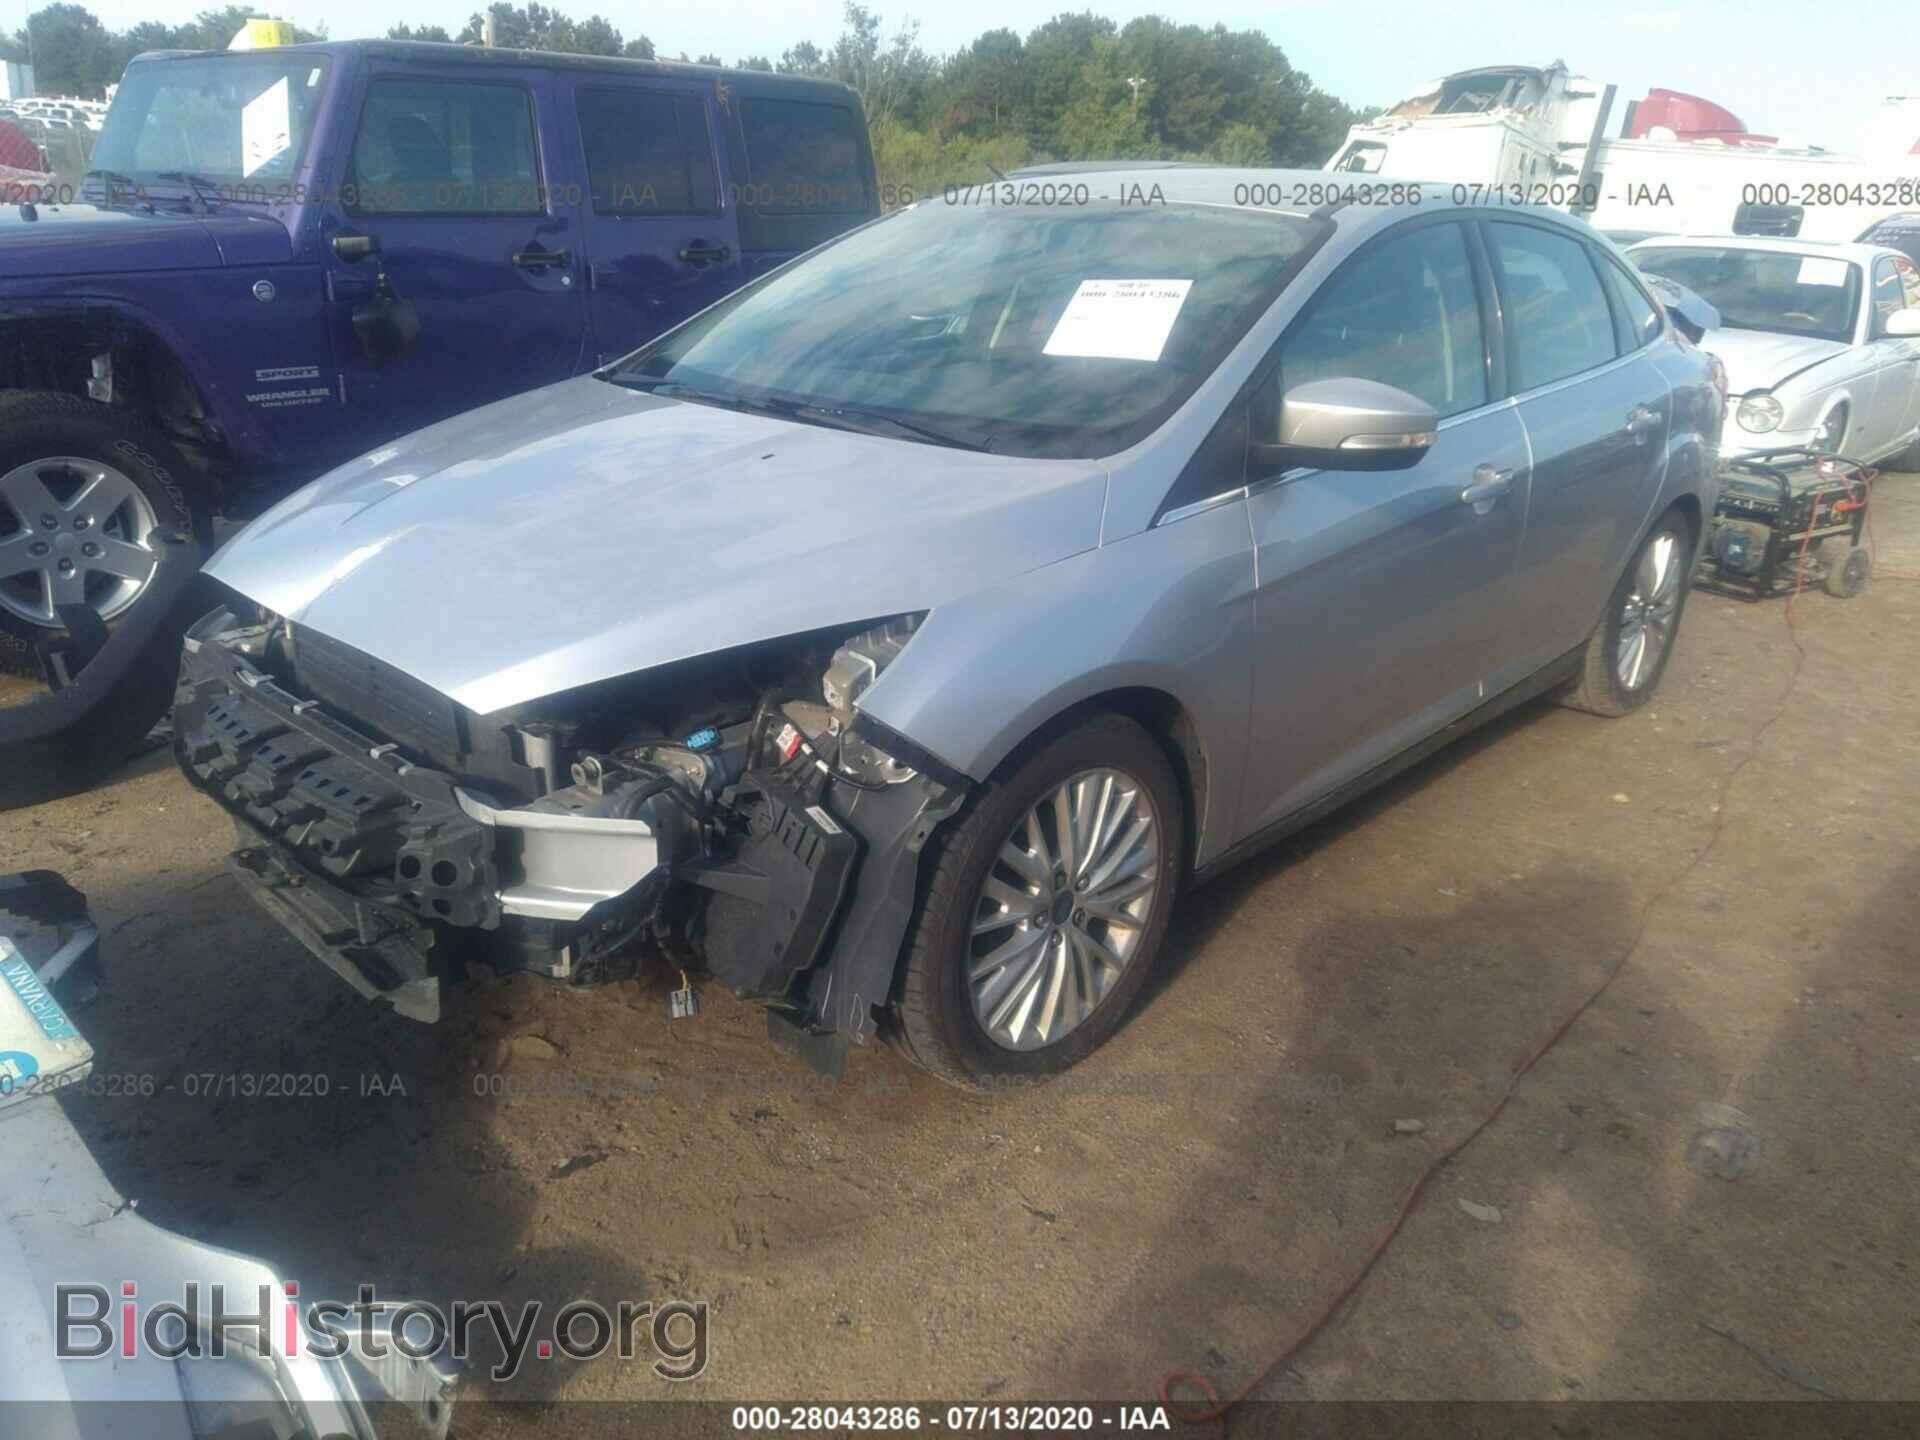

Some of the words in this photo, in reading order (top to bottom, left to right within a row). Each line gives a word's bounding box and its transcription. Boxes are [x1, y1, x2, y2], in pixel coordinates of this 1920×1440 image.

[256, 367, 319, 381] SPORT
[246, 388, 330, 402] WRANGLER
[7, 964, 65, 1032] CARVANA
